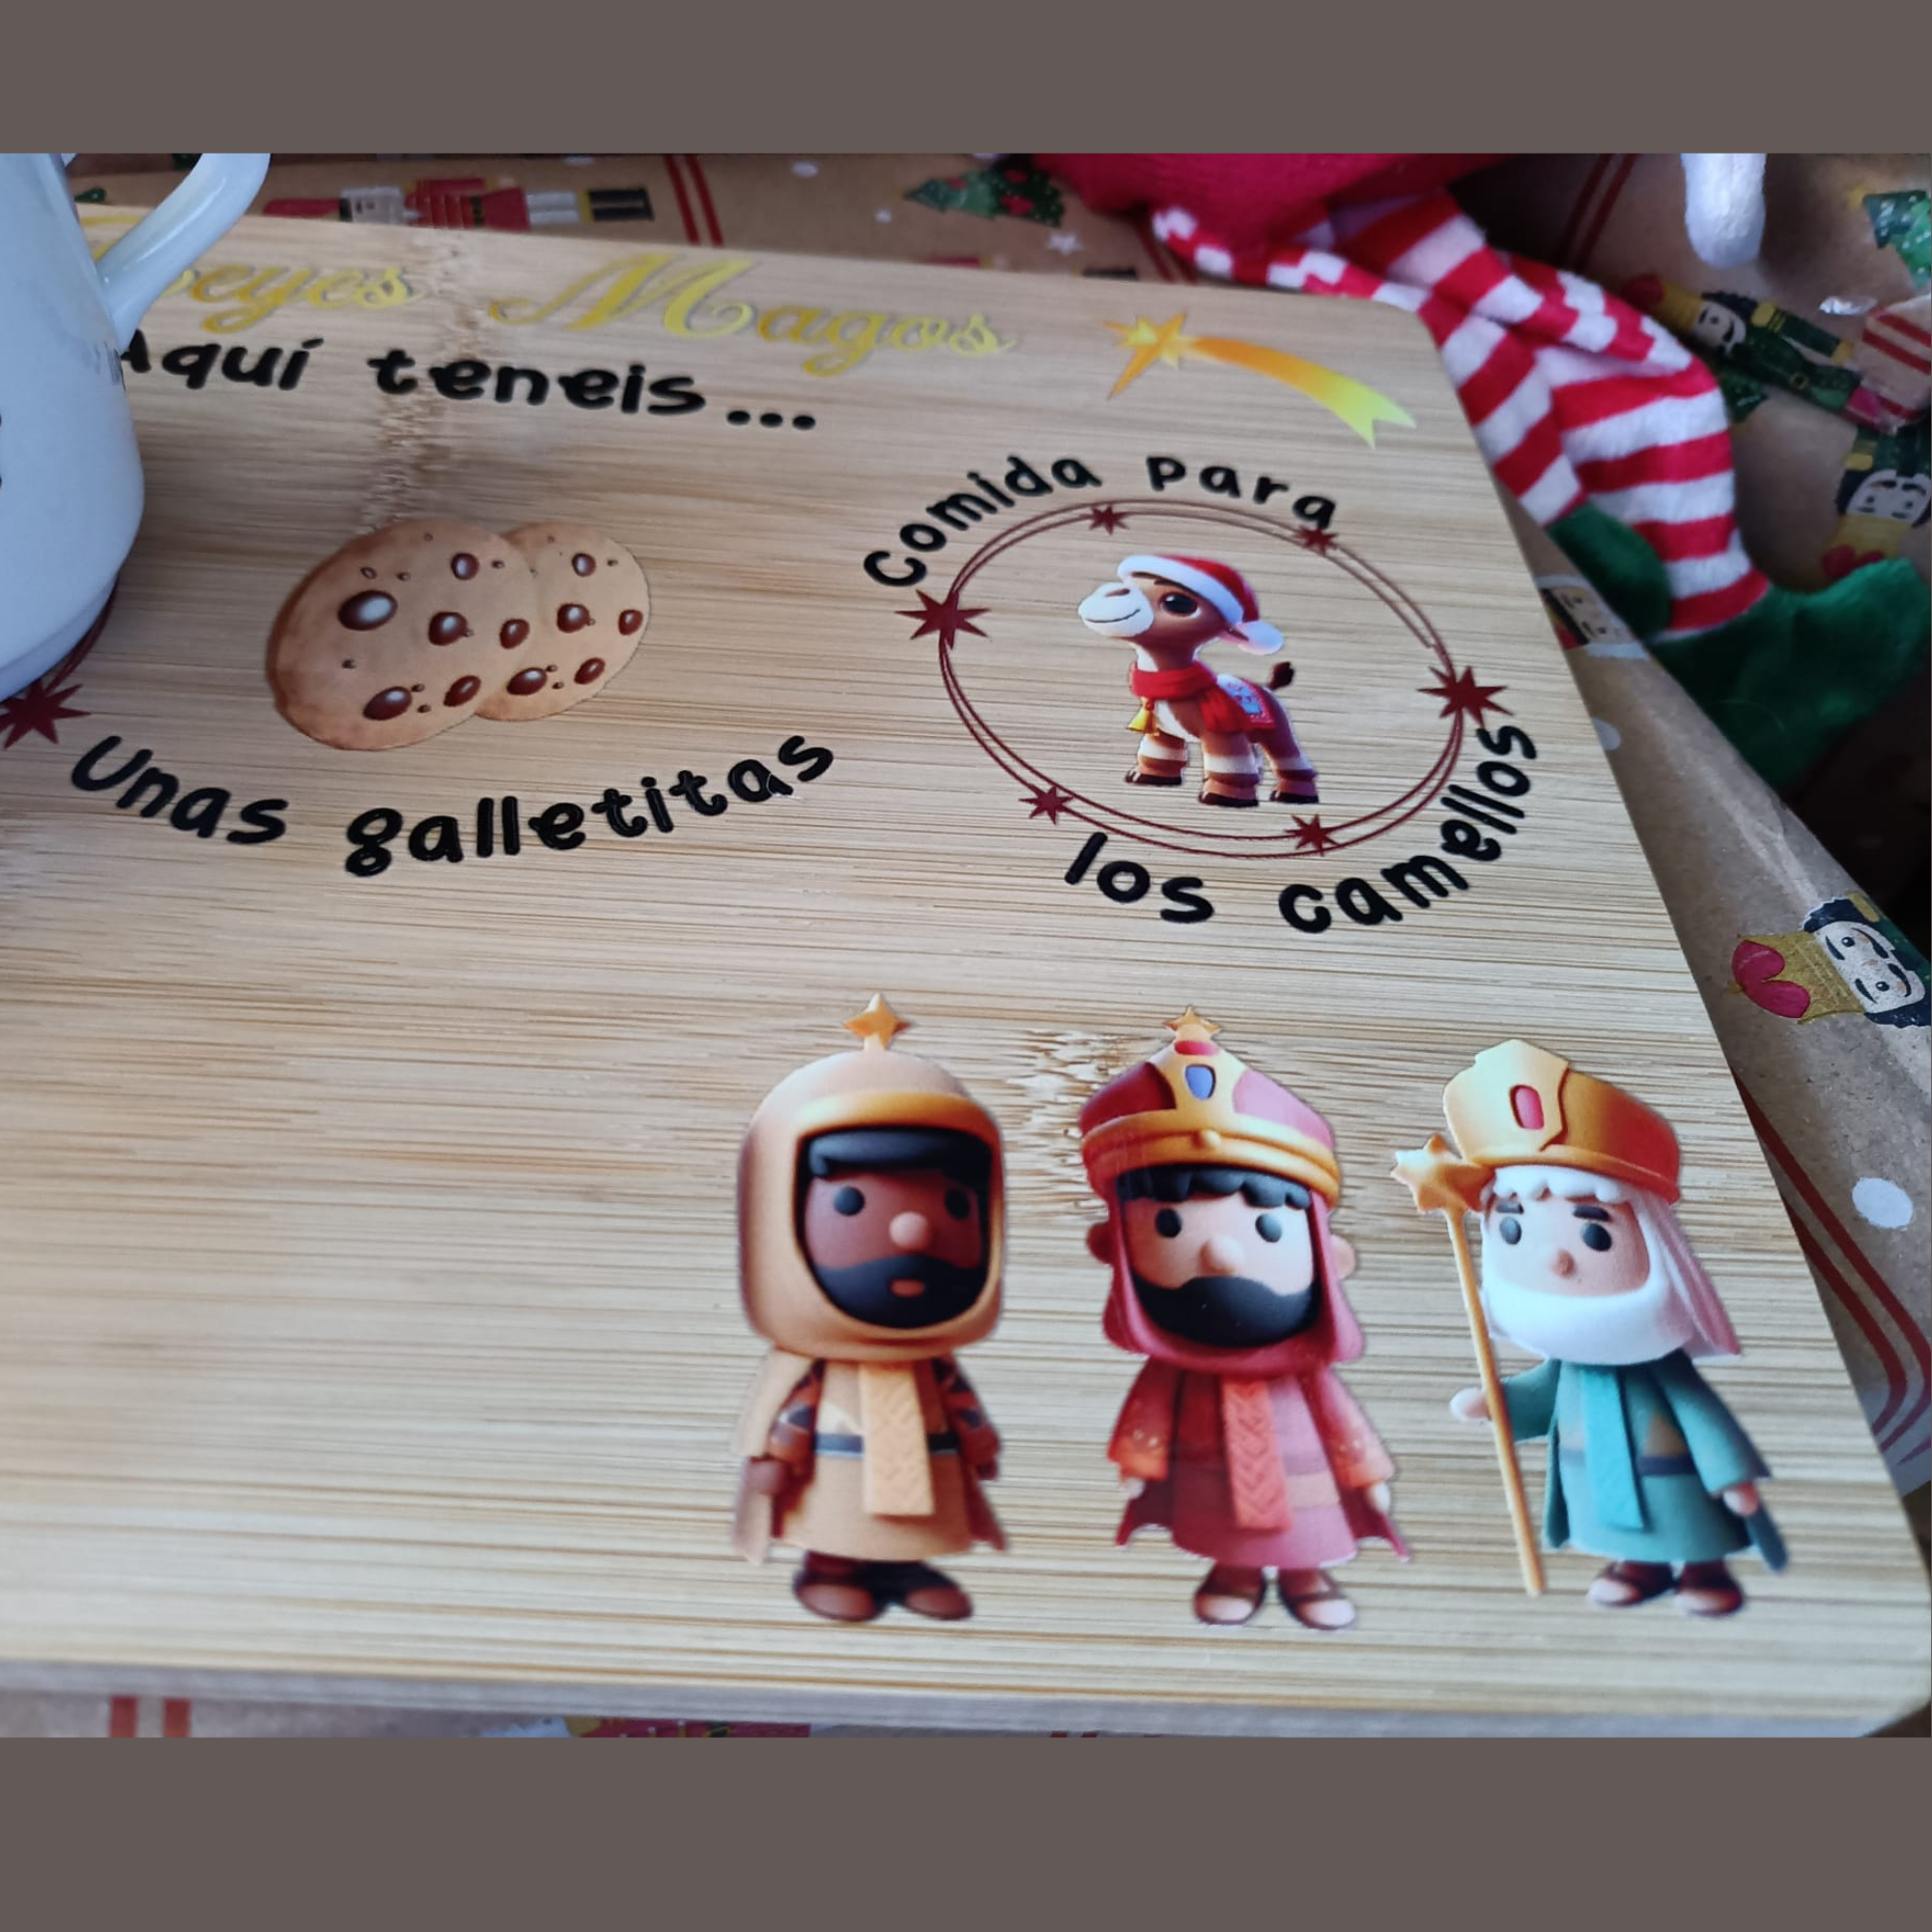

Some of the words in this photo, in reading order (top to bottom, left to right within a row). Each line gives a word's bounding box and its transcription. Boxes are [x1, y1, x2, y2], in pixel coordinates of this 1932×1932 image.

[488, 253, 1017, 377] Magos
[863, 456, 1103, 588] Comida
[1147, 456, 1336, 529] para
[71, 735, 289, 844] Unas
[345, 735, 835, 877] galletitas
[1064, 832, 1214, 923] los
[1278, 725, 1538, 934] camellos
